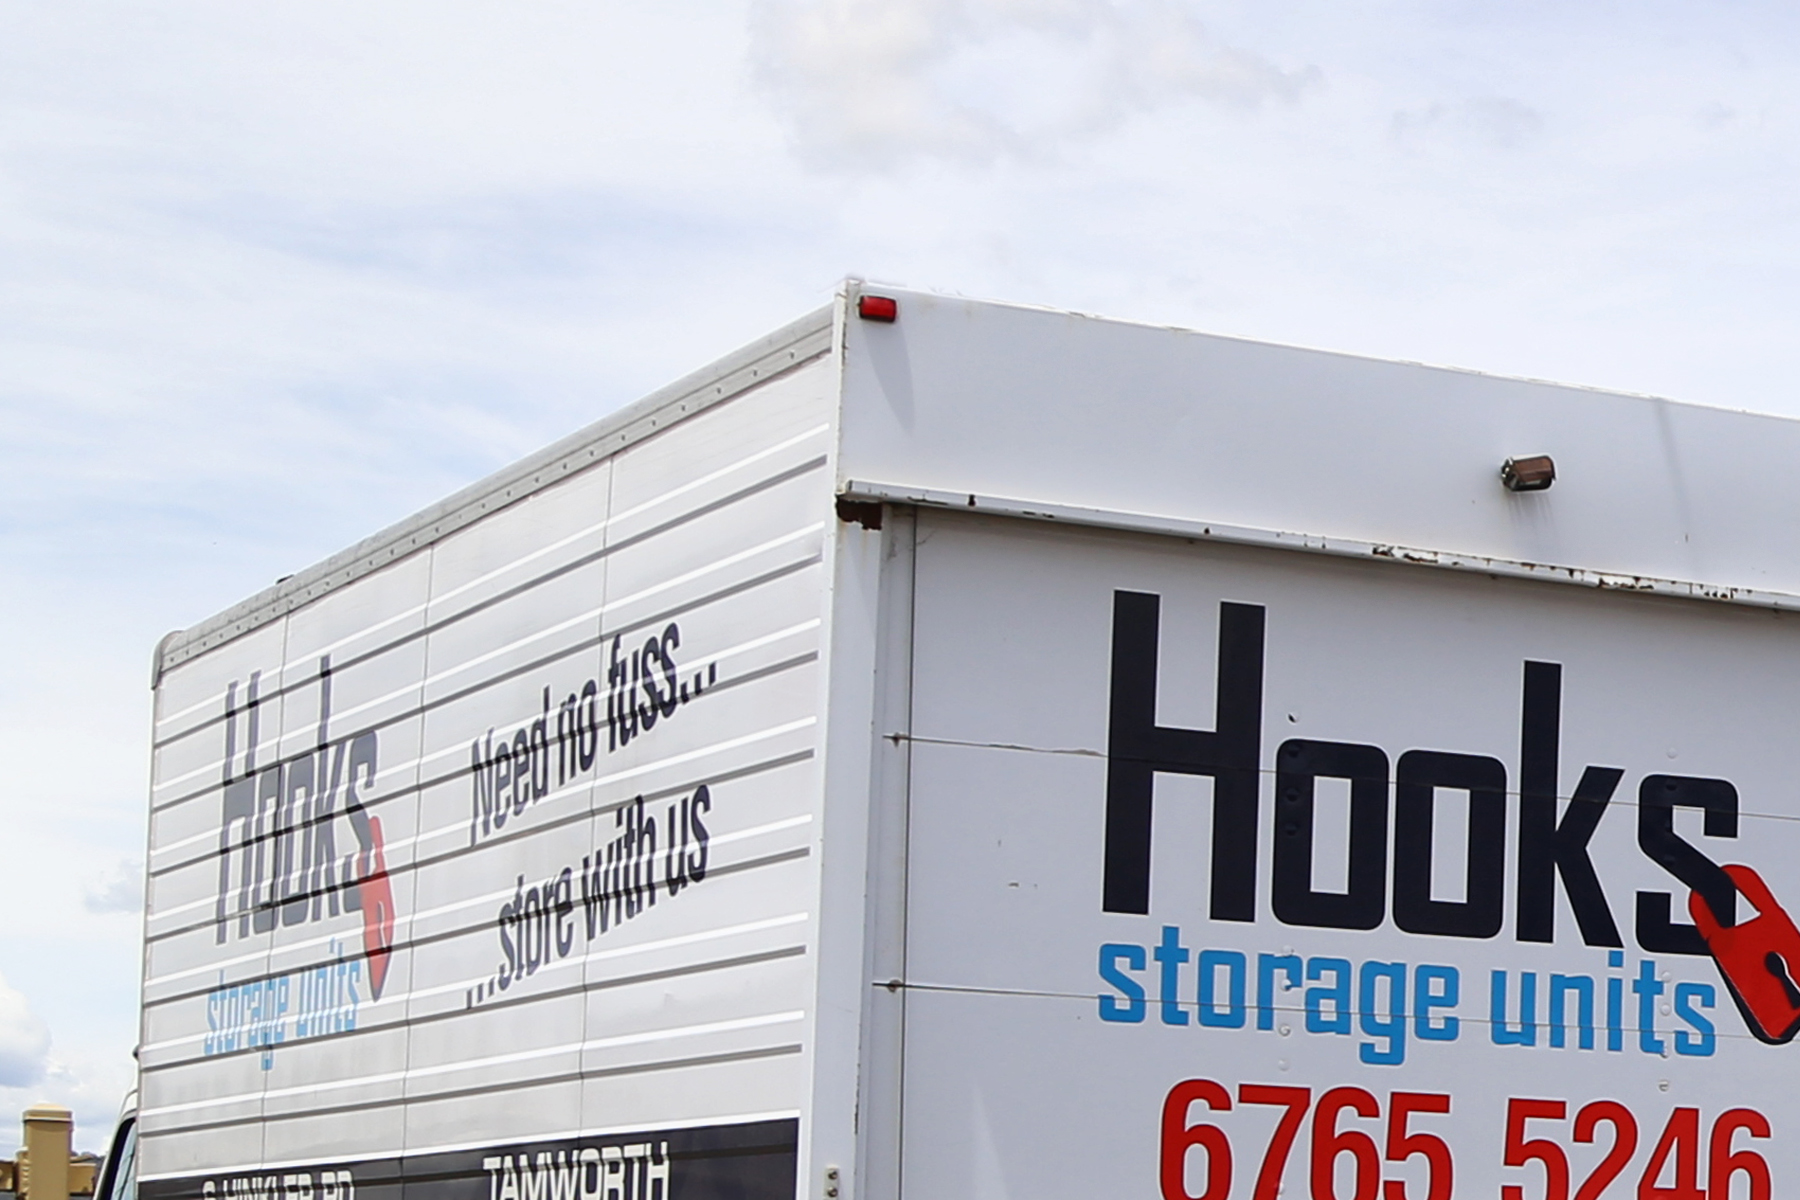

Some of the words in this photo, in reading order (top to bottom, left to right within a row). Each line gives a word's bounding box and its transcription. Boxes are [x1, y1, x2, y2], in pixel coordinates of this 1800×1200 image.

[216, 654, 379, 946] Hooks
[471, 684, 550, 847] Need
[558, 679, 598, 786] no
[608, 622, 717, 753] fuss...
[1102, 589, 1739, 957] Hooks
[582, 795, 656, 941] with
[666, 784, 711, 897] us
[204, 969, 290, 1071] storage
[296, 936, 361, 1038] units
[1098, 926, 1460, 1066] storage
[1491, 950, 1717, 1058] units
